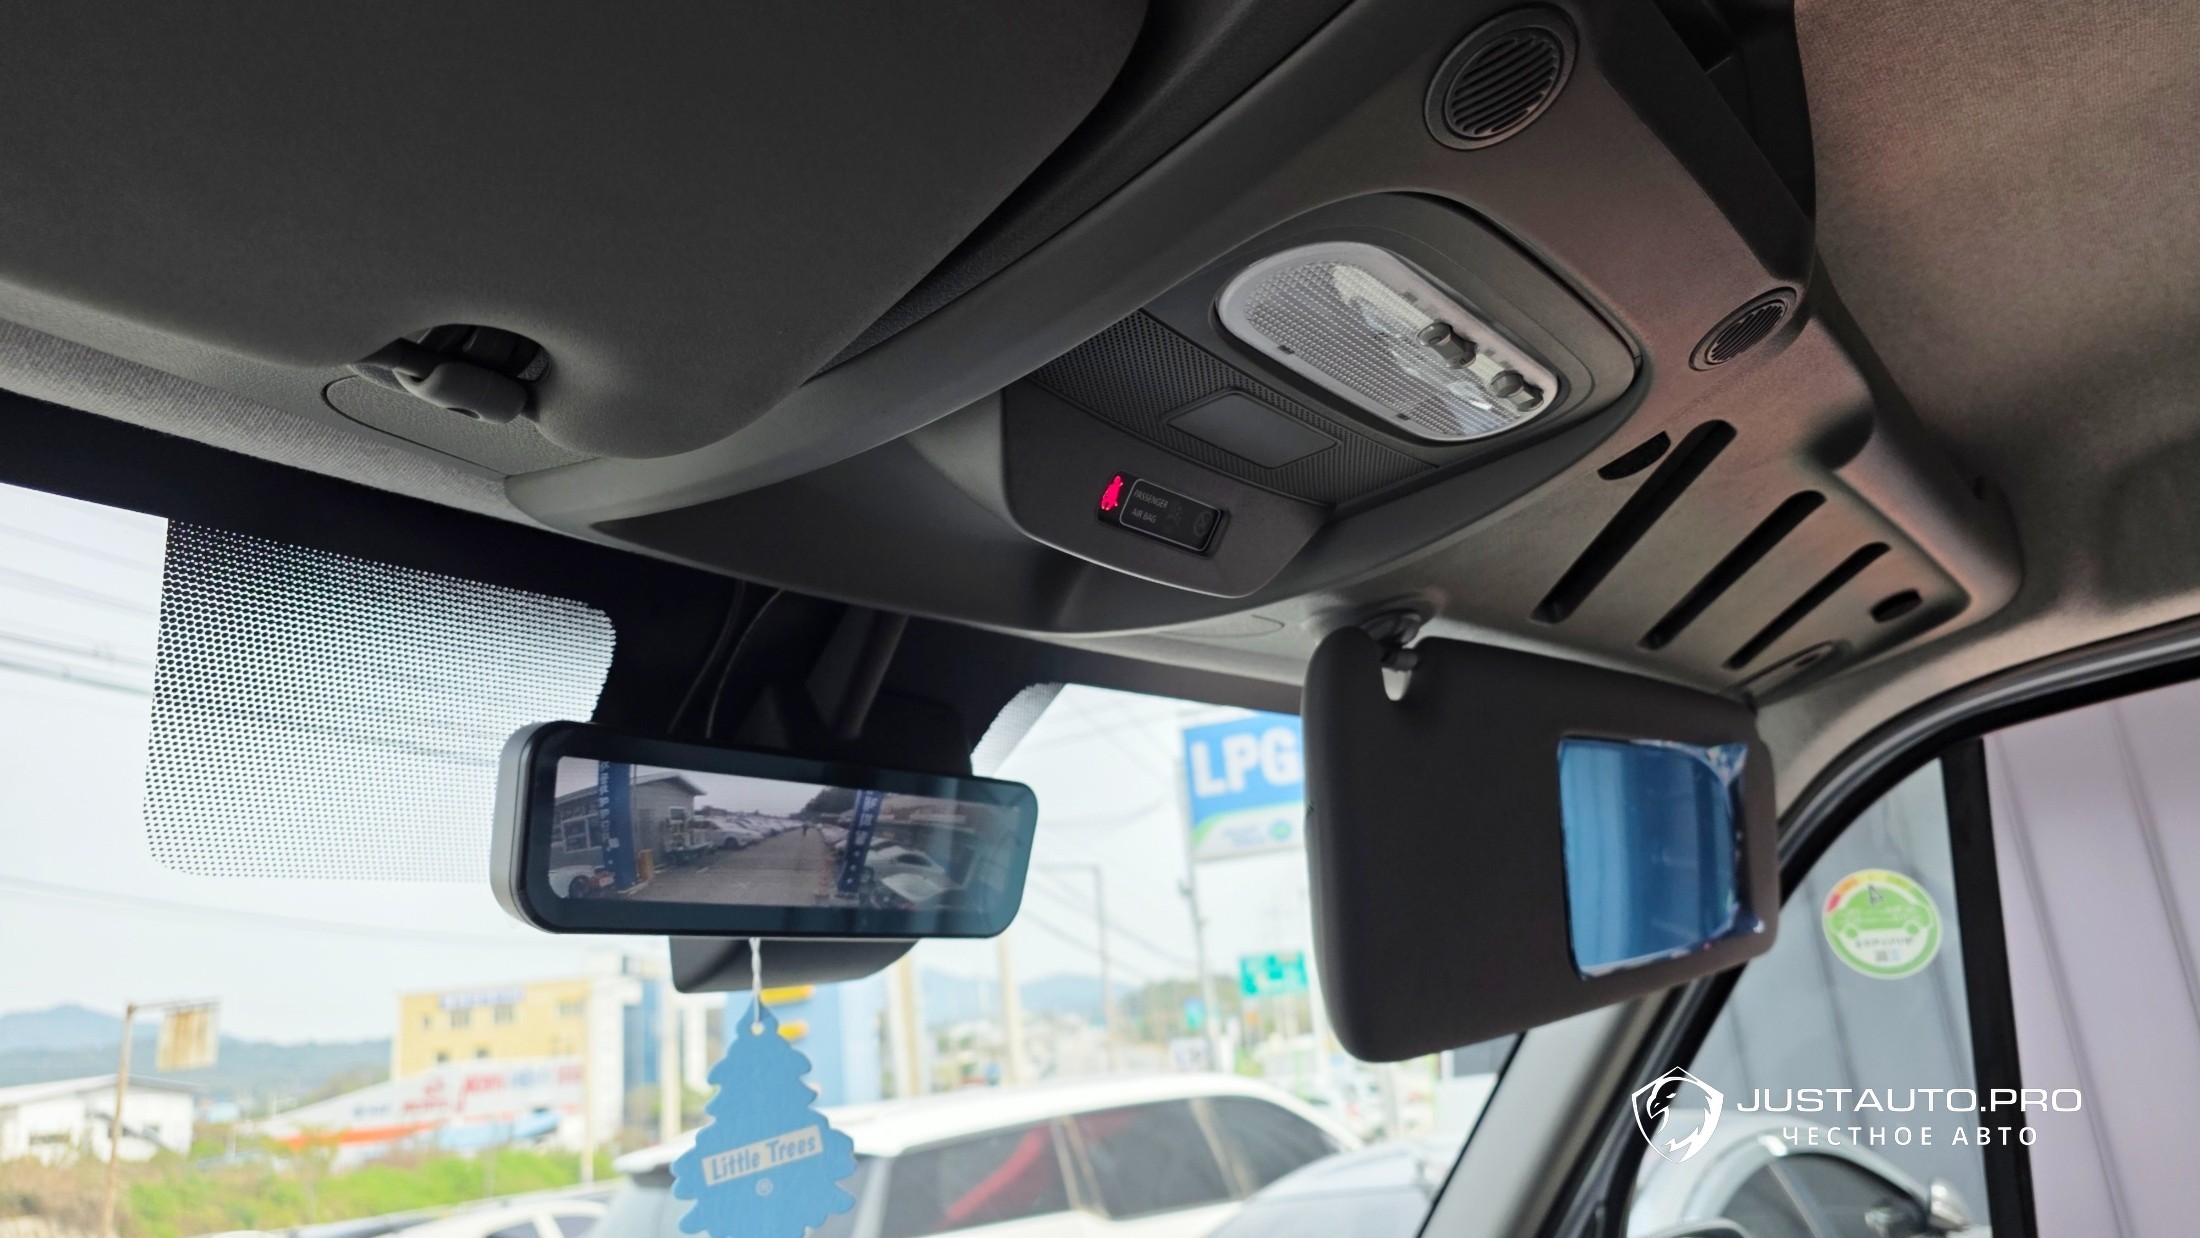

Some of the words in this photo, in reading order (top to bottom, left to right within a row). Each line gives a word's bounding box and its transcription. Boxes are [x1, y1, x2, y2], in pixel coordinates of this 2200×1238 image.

[1133, 489, 1169, 509] PASSENGER
[1131, 508, 1143, 520] AIR
[1142, 512, 1157, 524] BAG
[1189, 726, 1303, 799] LPG
[711, 1151, 761, 1181] Little
[765, 1136, 817, 1163] Trees
